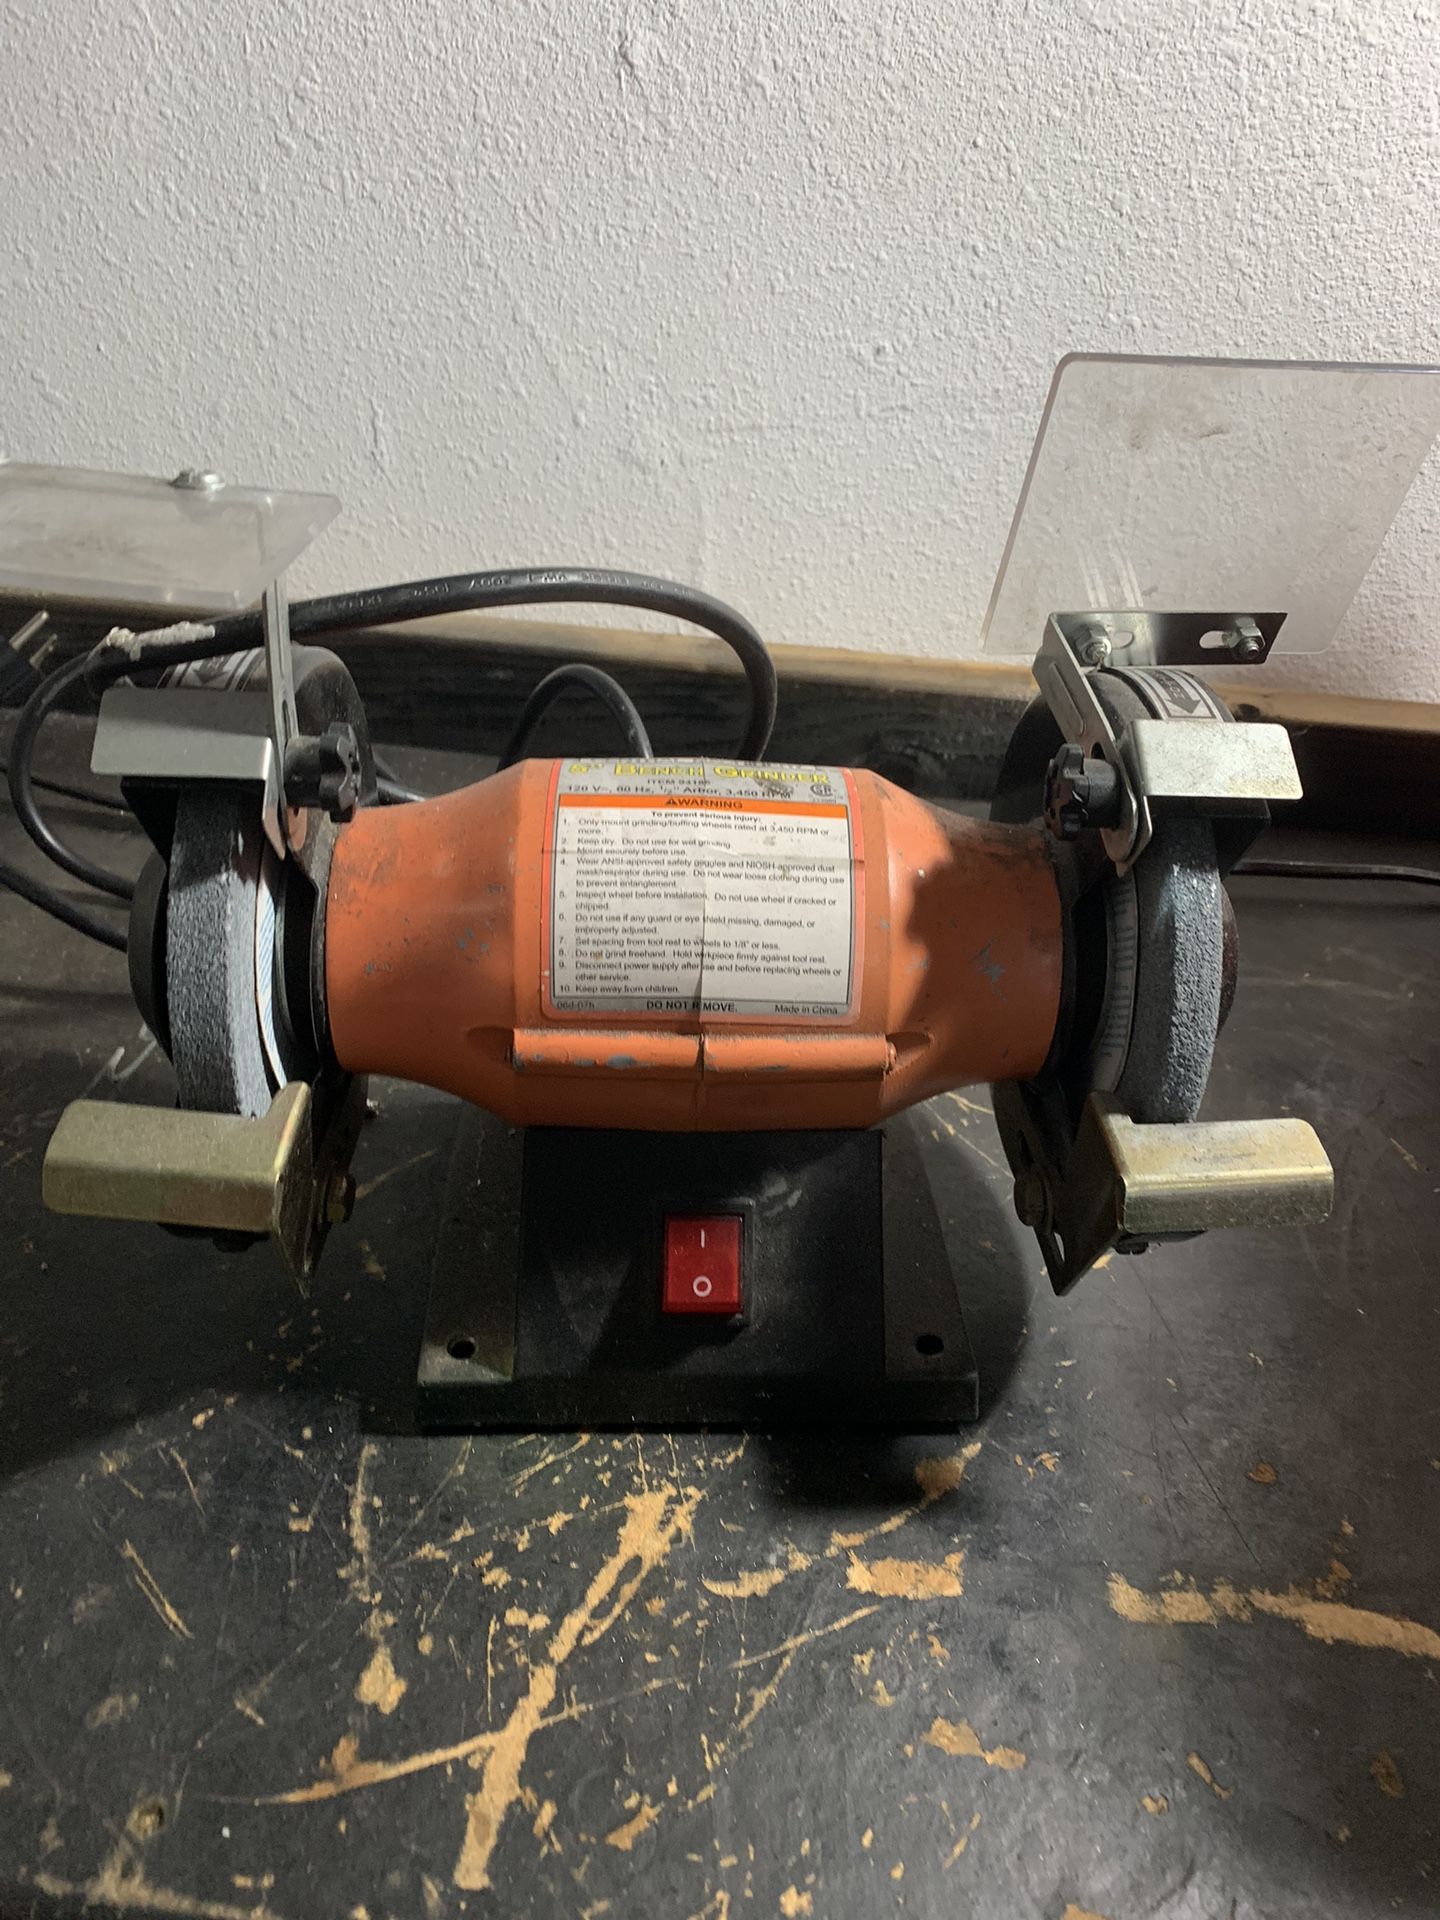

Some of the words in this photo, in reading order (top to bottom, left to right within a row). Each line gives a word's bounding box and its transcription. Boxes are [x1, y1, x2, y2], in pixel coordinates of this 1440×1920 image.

[683, 786, 721, 795] Arbor,
[725, 788, 758, 798] 3,450
[762, 790, 791, 799] RPM
[677, 798, 743, 810] WARNING
[664, 811, 698, 819] prevent
[578, 819, 599, 828] Only
[632, 819, 699, 829] grinding/buffing
[701, 822, 732, 830] wheels
[734, 823, 757, 831] rated
[770, 825, 794, 834] 3,450
[796, 827, 818, 835] RPM
[577, 838, 600, 846] Keep
[622, 838, 634, 846] Do
[668, 838, 679, 846] for
[606, 848, 640, 856] securely
[577, 858, 600, 866] Wear
[602, 858, 665, 868] ANSI-approved
[667, 859, 691, 867] safety
[694, 860, 727, 869] goggles
[728, 861, 744, 869] and
[746, 861, 815, 873] NIOSH-approved
[817, 864, 835, 873] dust
[642, 869, 668, 878] during
[693, 869, 706, 877] Do
[707, 870, 720, 878] not
[744, 872, 767, 880] loose
[769, 873, 800, 883] clothing
[802, 875, 828, 885] during
[586, 880, 618, 888] prevent
[576, 891, 606, 900] Inspect
[608, 891, 633, 899] wheel
[635, 891, 662, 899] before
[714, 892, 727, 901] Do
[728, 893, 742, 902] not
[761, 895, 785, 903] wheel
[794, 897, 827, 906] cracked
[576, 913, 588, 921] Do
[590, 913, 603, 921] not
[622, 913, 628, 921] if
[630, 914, 645, 923] any
[647, 914, 672, 924] guard
[674, 914, 682, 922] or
[684, 915, 700, 924] eye
[728, 916, 761, 927] missing,
[764, 918, 804, 929] damaged,
[575, 926, 619, 936] improperly
[576, 937, 590, 946] Set
[592, 937, 625, 947] spacing
[627, 937, 646, 946] from
[648, 937, 662, 946] tool
[665, 937, 680, 946] rest
[683, 938, 691, 946] to
[723, 940, 731, 948] to
[762, 941, 780, 950] less.
[576, 949, 588, 957] Do
[589, 949, 603, 957] not
[605, 949, 626, 959] grind
[673, 949, 692, 957] Hold
[737, 951, 758, 961] firmly
[761, 953, 790, 963] against
[792, 954, 808, 963] tool
[576, 961, 622, 970] Disconnect
[624, 962, 650, 971] power
[652, 962, 679, 972] supply
[681, 961, 700, 970] after
[717, 964, 733, 973] and
[735, 964, 761, 973] before
[763, 966, 801, 977] replacing
[802, 967, 830, 976] wheels
[832, 969, 841, 977] or
[575, 972, 597, 981] other
[575, 984, 598, 993] Keep
[600, 985, 622, 995] away
[624, 984, 643, 993] from
[646, 1001, 663, 1010] DO
[666, 1001, 688, 1010] NOT
[774, 1004, 799, 1014] Made
[802, 1005, 810, 1013] in
